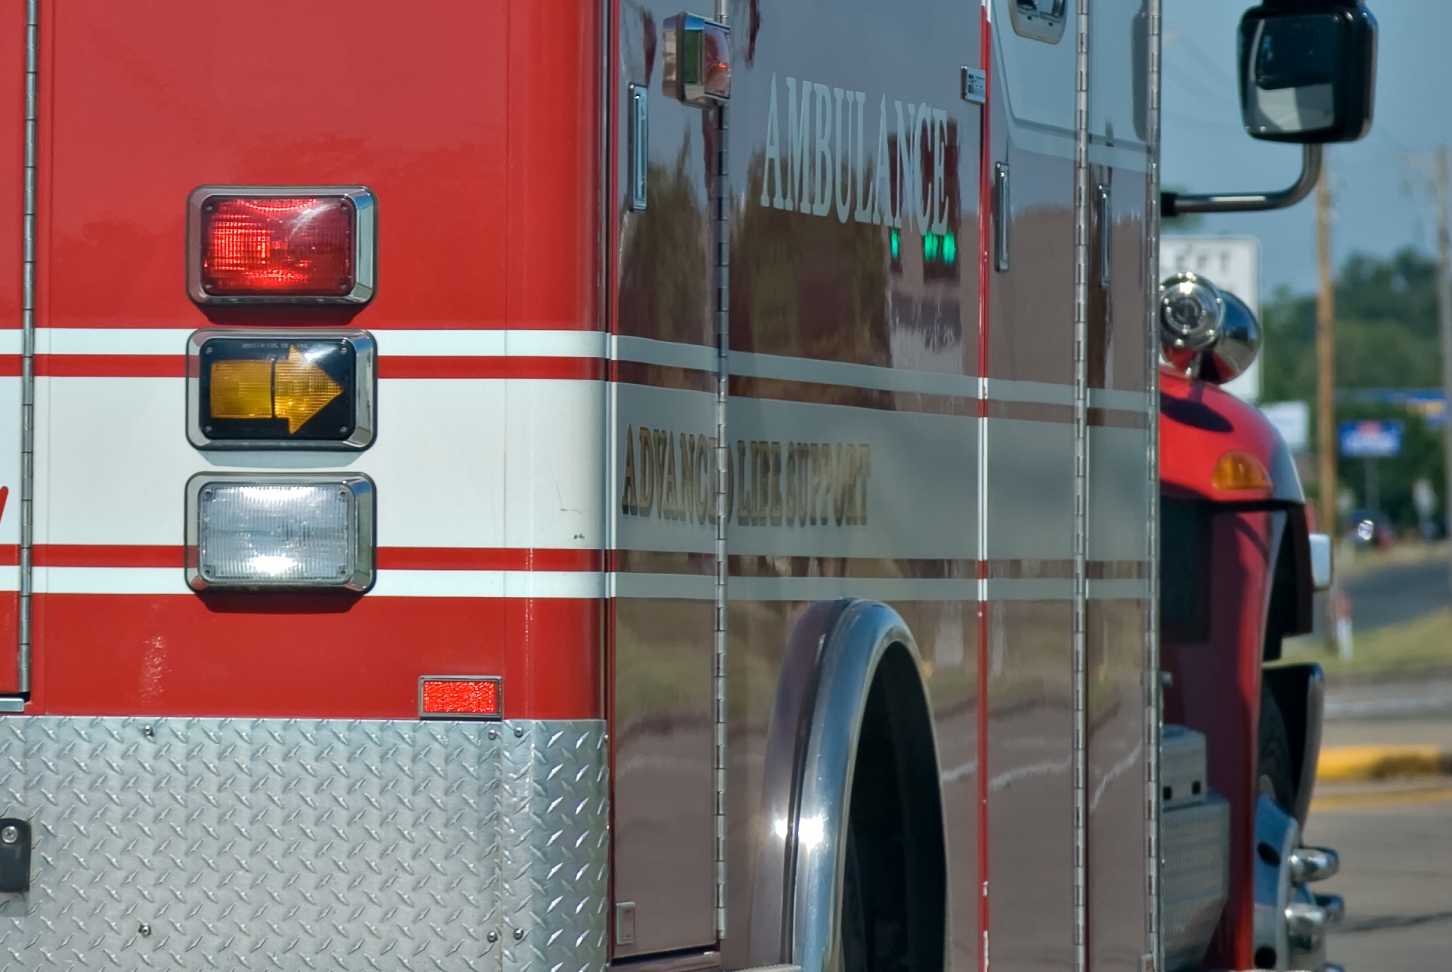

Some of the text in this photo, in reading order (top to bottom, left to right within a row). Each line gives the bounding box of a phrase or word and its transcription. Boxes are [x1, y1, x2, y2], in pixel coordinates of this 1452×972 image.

[760, 71, 948, 236] AMBULANCE
[737, 439, 782, 527] LIFE
[786, 439, 871, 527] SUPPORT
